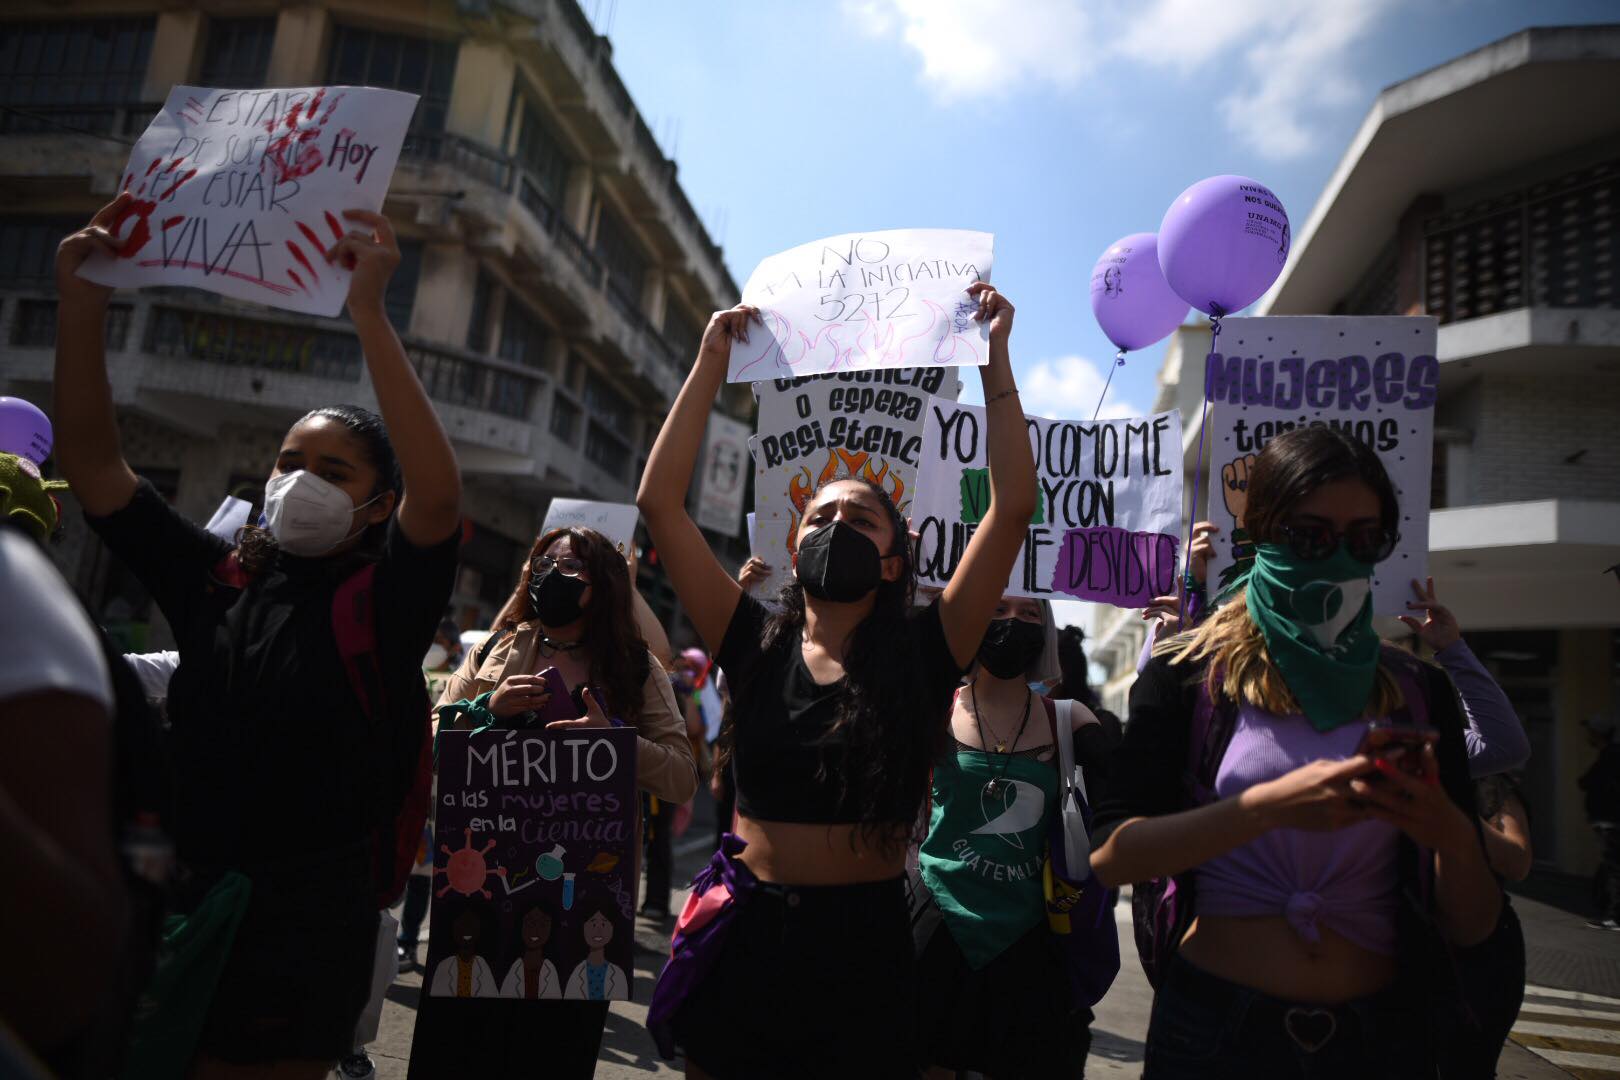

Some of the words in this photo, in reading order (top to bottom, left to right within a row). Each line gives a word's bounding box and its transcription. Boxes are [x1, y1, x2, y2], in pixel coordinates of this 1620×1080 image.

[170, 136, 213, 164] DE
[328, 132, 378, 184] HOY
[203, 170, 301, 214] ESTAR
[1245, 195, 1262, 205] NOS
[161, 216, 272, 282] VIVA
[821, 238, 890, 266] NO
[819, 269, 846, 289] LA
[861, 259, 981, 288] INICIATIVA
[814, 287, 921, 322] 5272
[761, 416, 923, 469] Resistenc
[933, 405, 978, 464] YO
[1046, 422, 1119, 479] COMO
[1123, 415, 1172, 478] ME
[1041, 475, 1064, 528] Y
[1062, 479, 1115, 528] CON
[914, 515, 980, 582] QUI
[1068, 530, 1177, 597] DESVISTO
[465, 729, 618, 788] MÉRITO
[442, 792, 457, 808] a
[461, 788, 489, 808] las
[501, 790, 621, 817] mujeres
[469, 816, 495, 832] en
[497, 813, 516, 833] la
[520, 817, 627, 845] Ciencia
